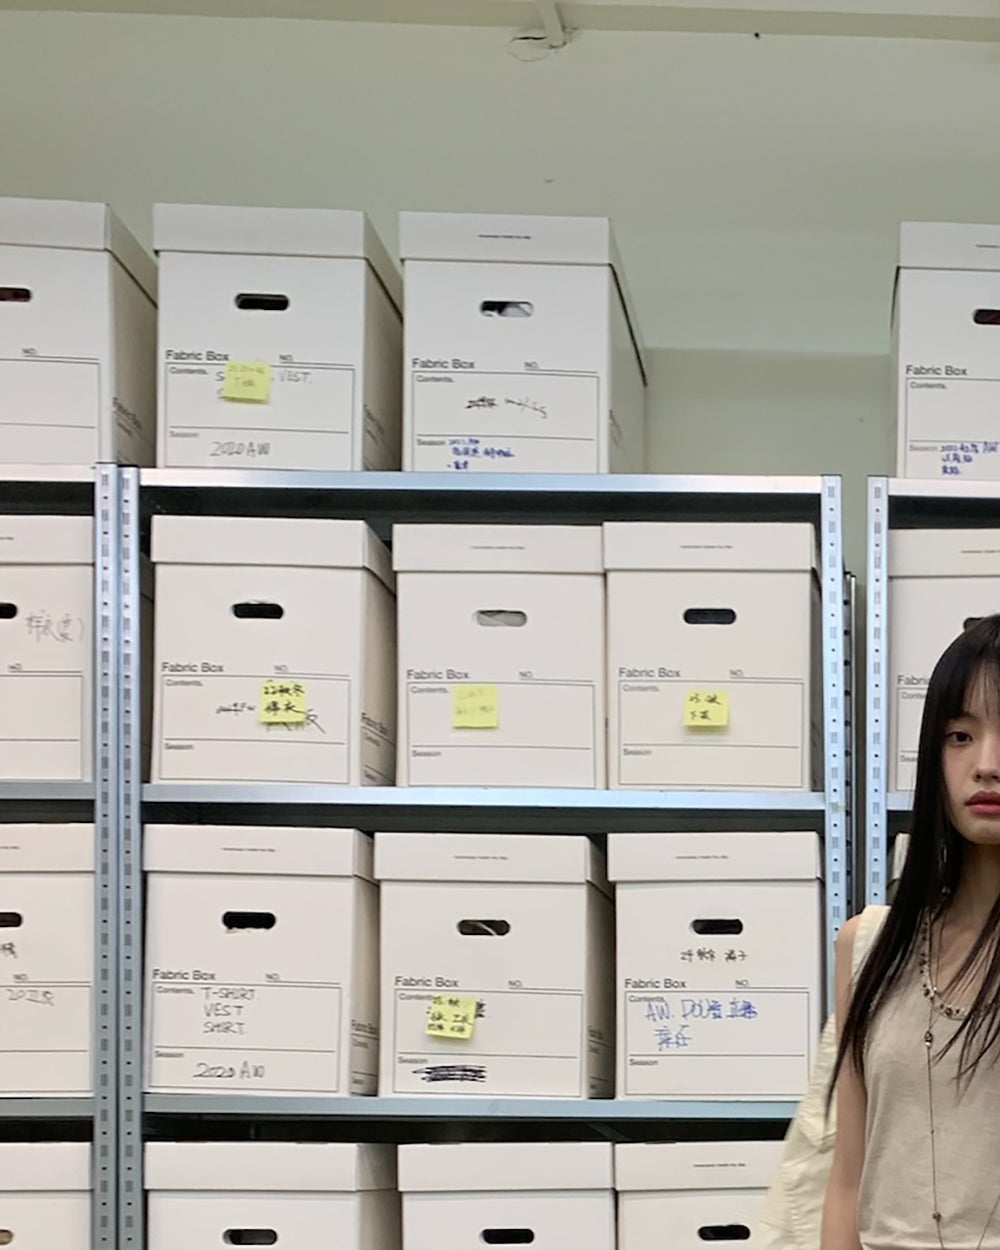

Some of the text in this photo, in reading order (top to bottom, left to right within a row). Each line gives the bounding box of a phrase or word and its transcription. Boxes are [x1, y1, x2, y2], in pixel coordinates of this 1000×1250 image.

[166, 350, 229, 361] Fabric Box
[412, 358, 475, 369] Fabric Box
[906, 365, 968, 376] Fabric Box
[161, 662, 224, 673] Fabric Box
[618, 668, 681, 678] Fabric Box
[406, 669, 470, 680] Fabric Box
[153, 969, 215, 980] Fabric Box
[395, 976, 458, 987] Fabric Box
[625, 979, 687, 989] Fabric Box
[204, 1003, 244, 1016] VEST
[203, 1021, 245, 1034] SHIRT
